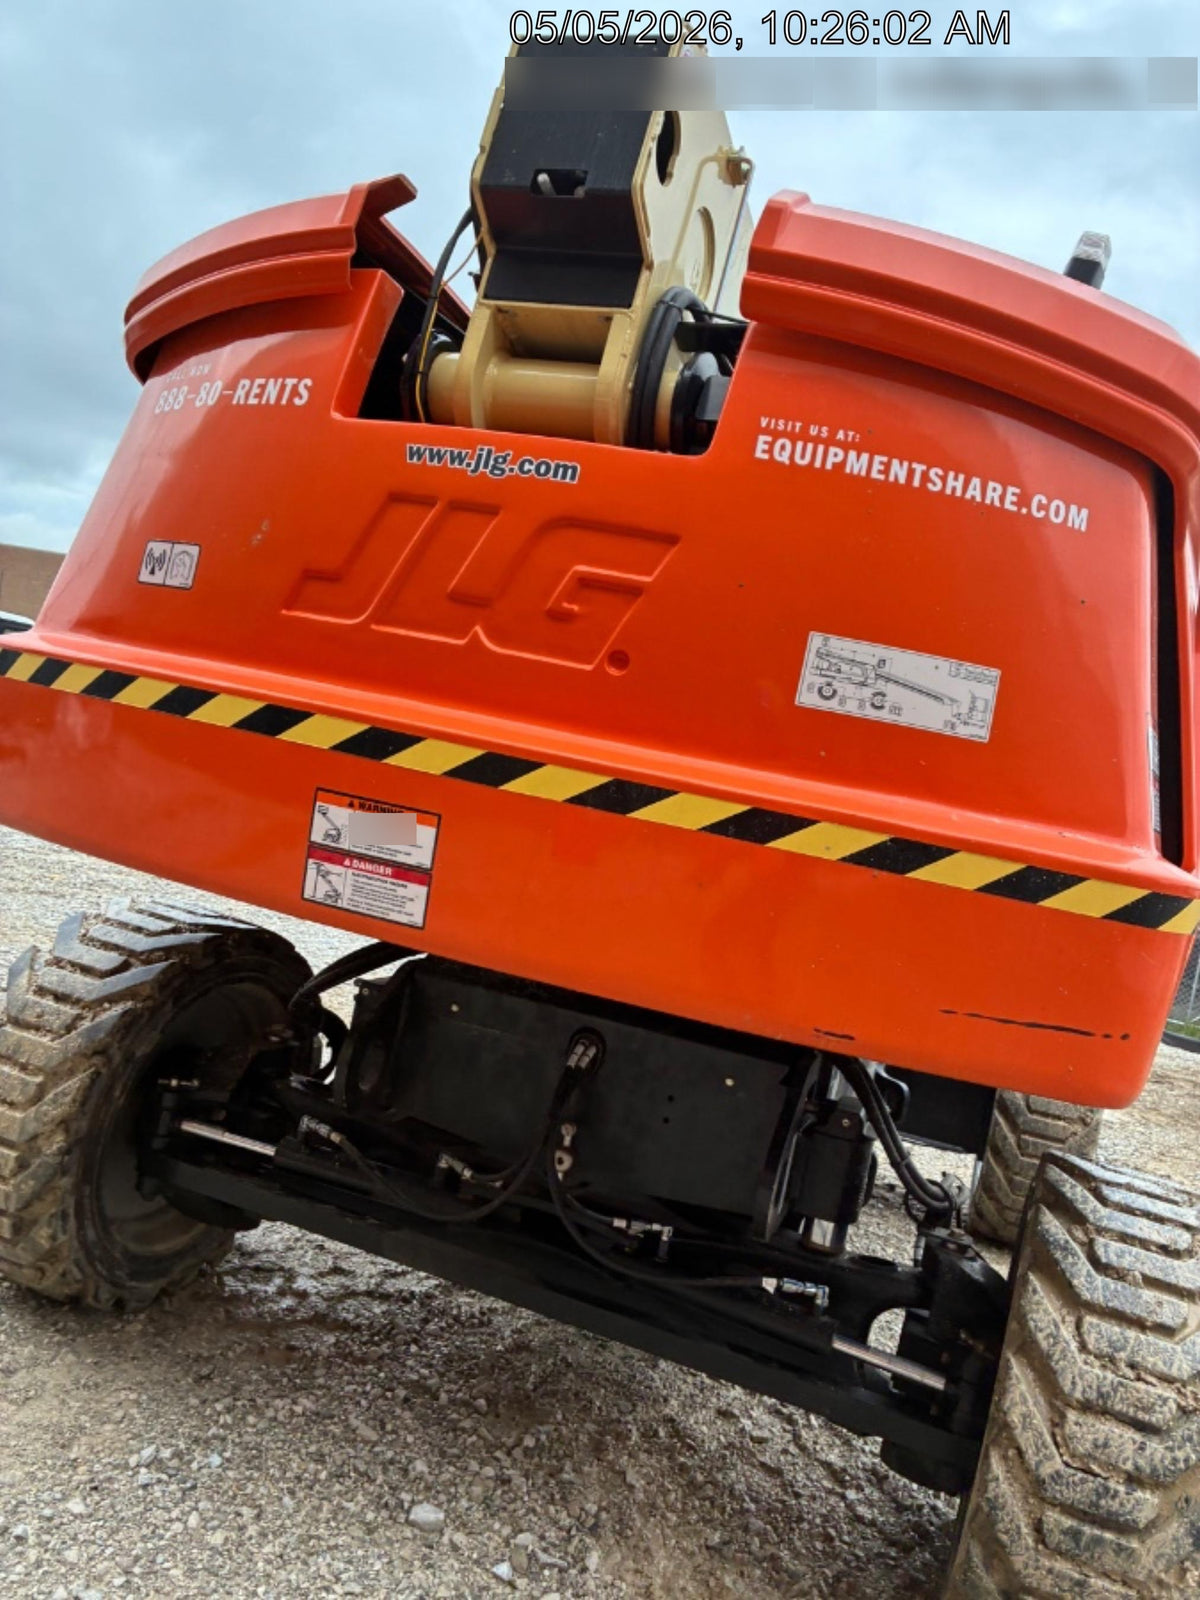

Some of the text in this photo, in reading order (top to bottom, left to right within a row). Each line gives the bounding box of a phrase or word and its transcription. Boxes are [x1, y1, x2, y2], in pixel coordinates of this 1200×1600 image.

[154, 377, 313, 414] 888-80-RENTS
[760, 416, 860, 442] VISIT US AT:
[406, 443, 581, 484] www.jlg.com
[754, 434, 1089, 532] EQUIPMENTSHARE.COM
[358, 800, 404, 813] WARNIN
[352, 859, 392, 877] DANGER
